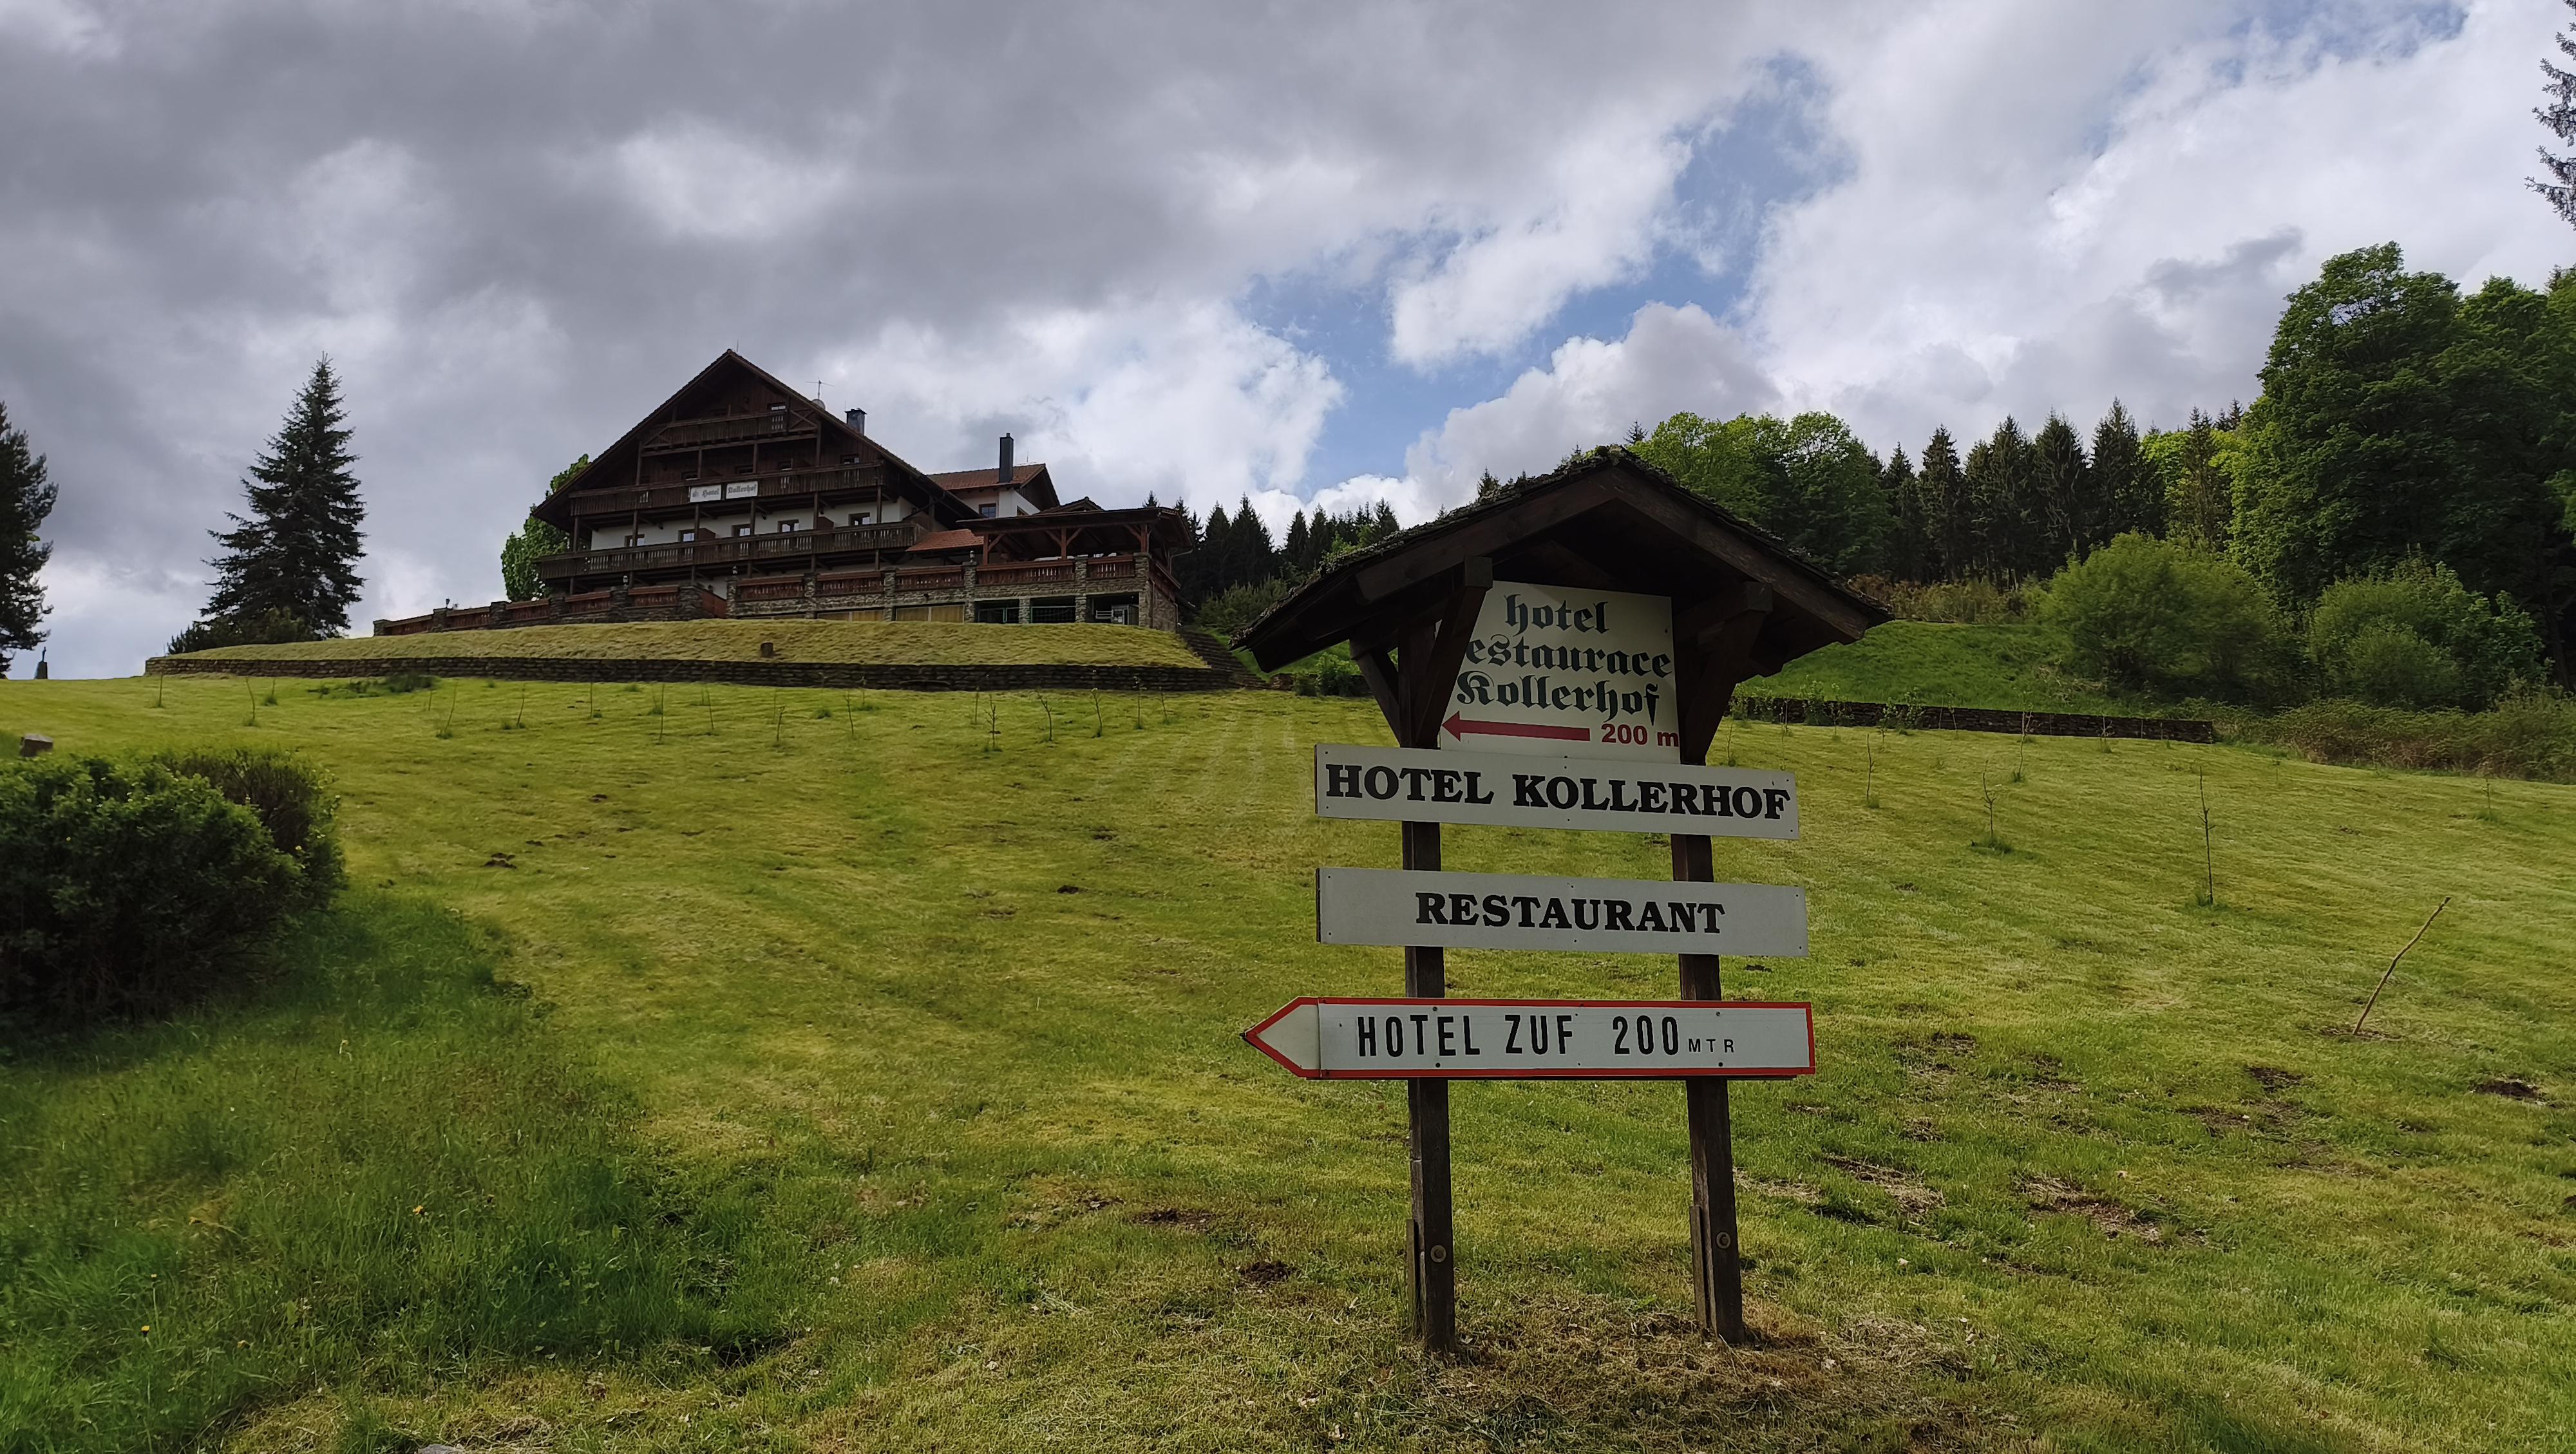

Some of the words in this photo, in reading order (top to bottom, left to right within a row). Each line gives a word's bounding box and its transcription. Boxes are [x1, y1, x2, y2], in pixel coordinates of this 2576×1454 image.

[1466, 634, 1672, 678] estaurace
[1457, 670, 1660, 726] Kollerhof
[1601, 723, 1648, 746] 200
[1657, 731, 1680, 747] m
[1325, 764, 1494, 805] HOTEL
[1513, 775, 1790, 820] KOLLERHOF
[1416, 892, 1725, 934] RESTAURANT
[1358, 1015, 1481, 1057] HOTEL
[1505, 1014, 1574, 1055] ZUF
[1614, 1015, 1679, 1056] 200
